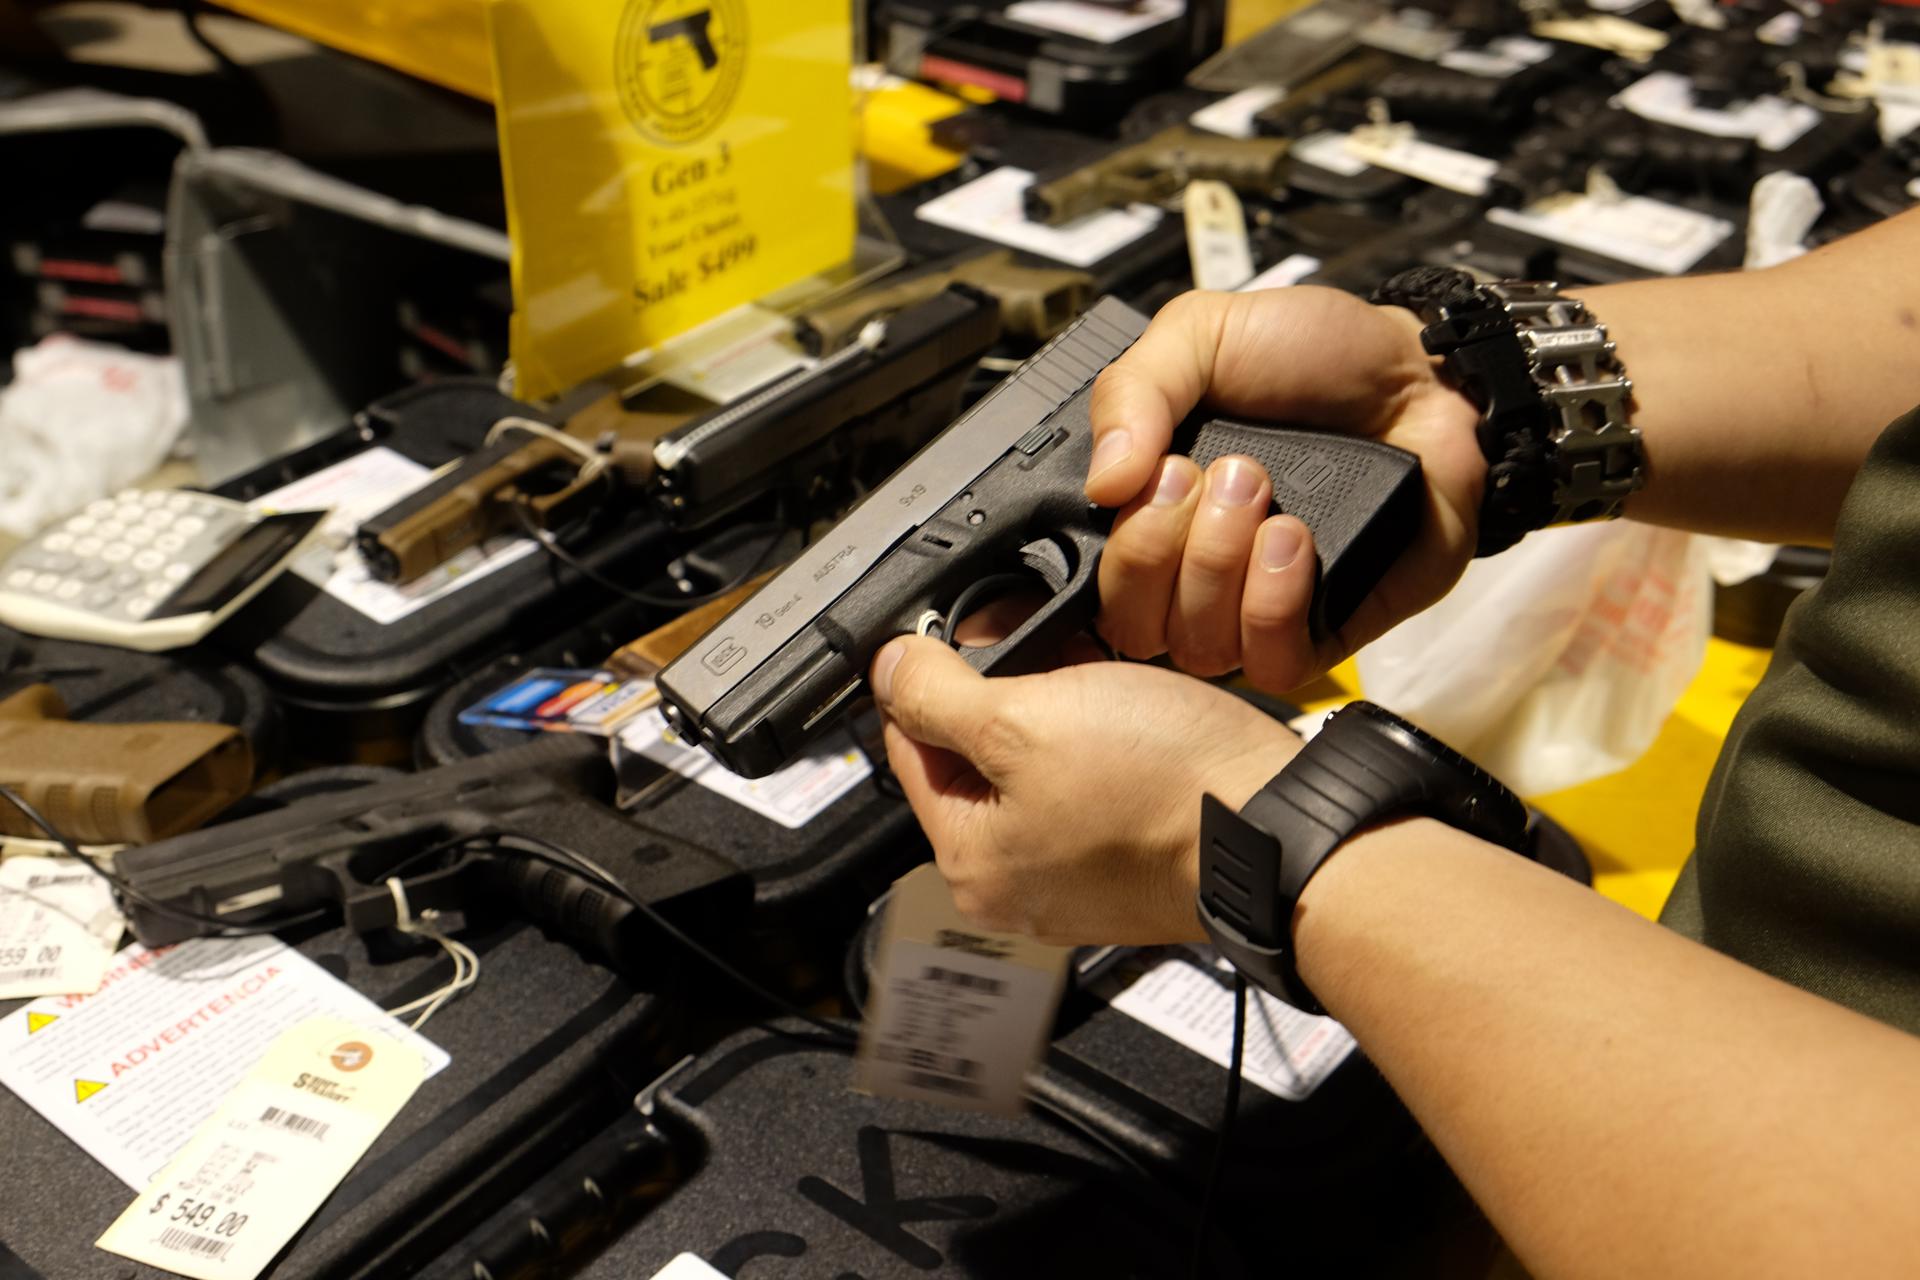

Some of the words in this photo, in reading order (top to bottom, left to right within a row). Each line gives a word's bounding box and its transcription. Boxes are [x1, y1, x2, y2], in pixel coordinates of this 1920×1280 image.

[632, 268, 689, 316] Sale
[813, 543, 857, 583] AUSTRIA
[754, 612, 775, 630] 19
[110, 966, 282, 1078] ADVERTENCIA
[149, 1193, 171, 1215] $
[170, 1197, 250, 1238] 549.00
